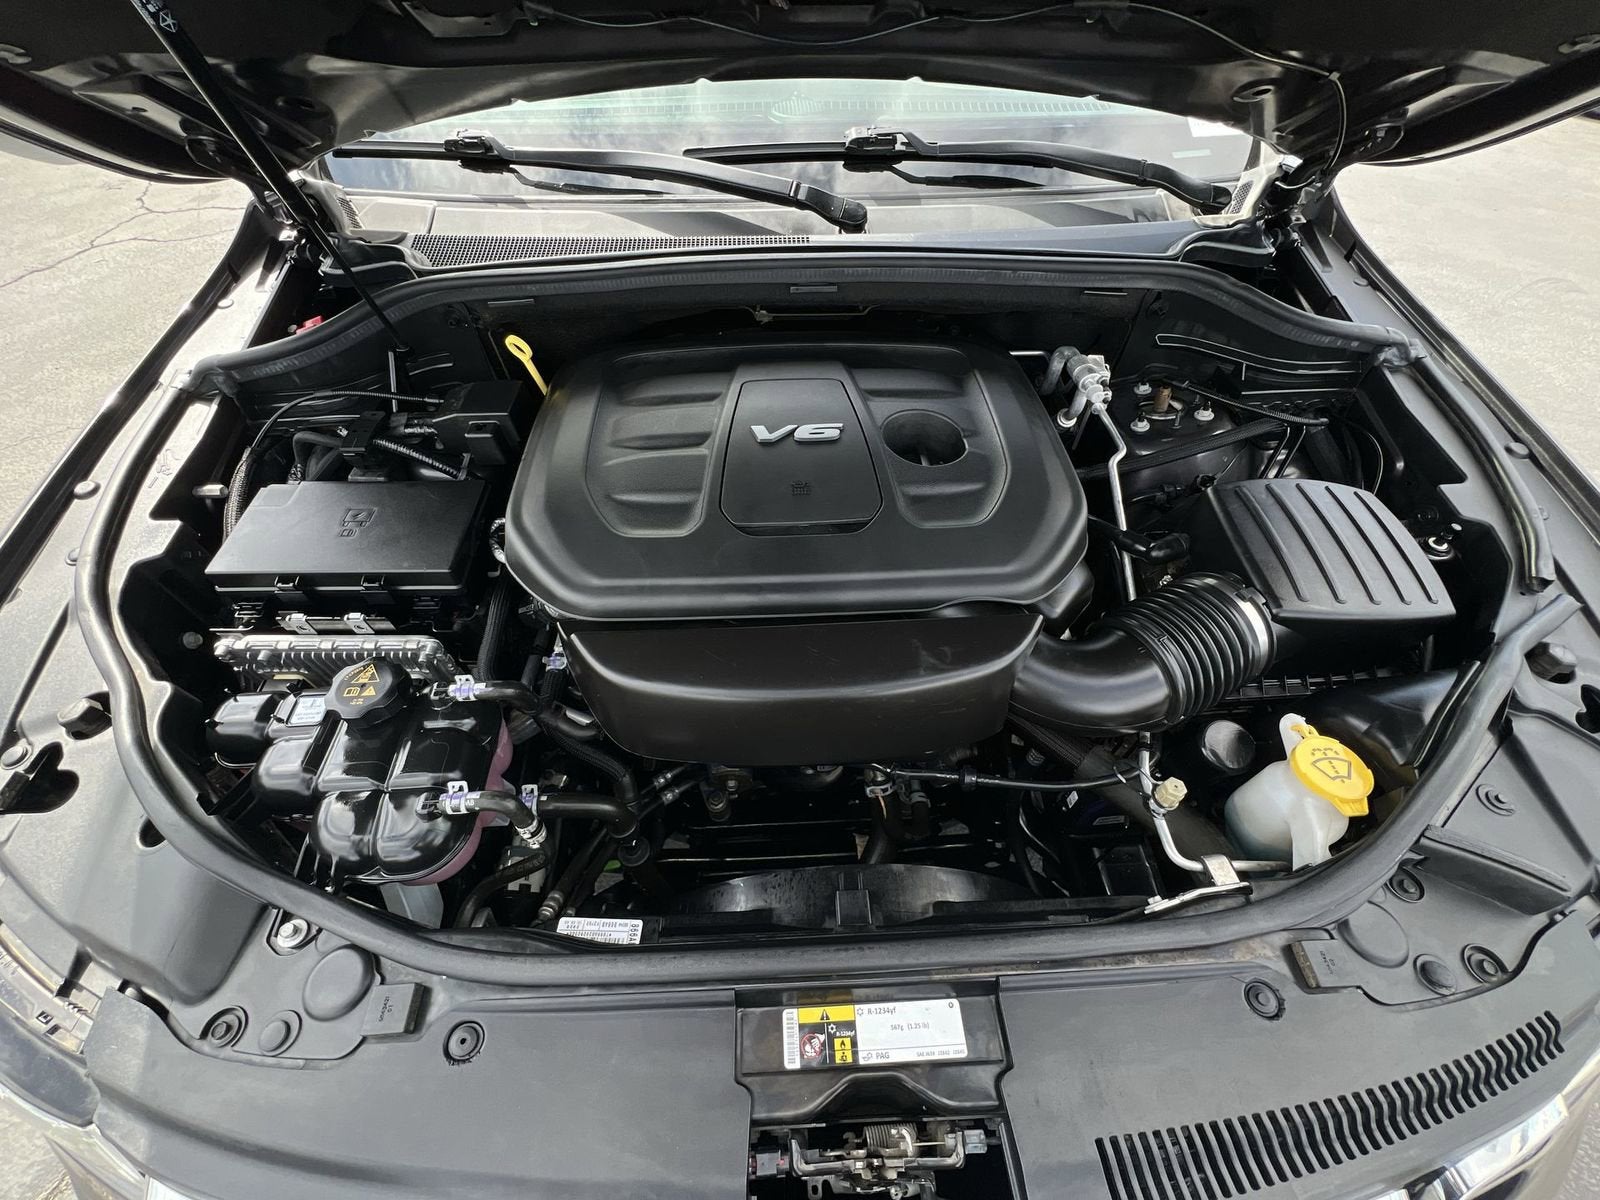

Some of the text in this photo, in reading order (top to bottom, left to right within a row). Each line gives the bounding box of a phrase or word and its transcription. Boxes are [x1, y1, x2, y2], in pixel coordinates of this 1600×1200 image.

[750, 423, 844, 442] V6
[867, 1006, 897, 1016] R-1234yf
[876, 1052, 890, 1060] PAG
